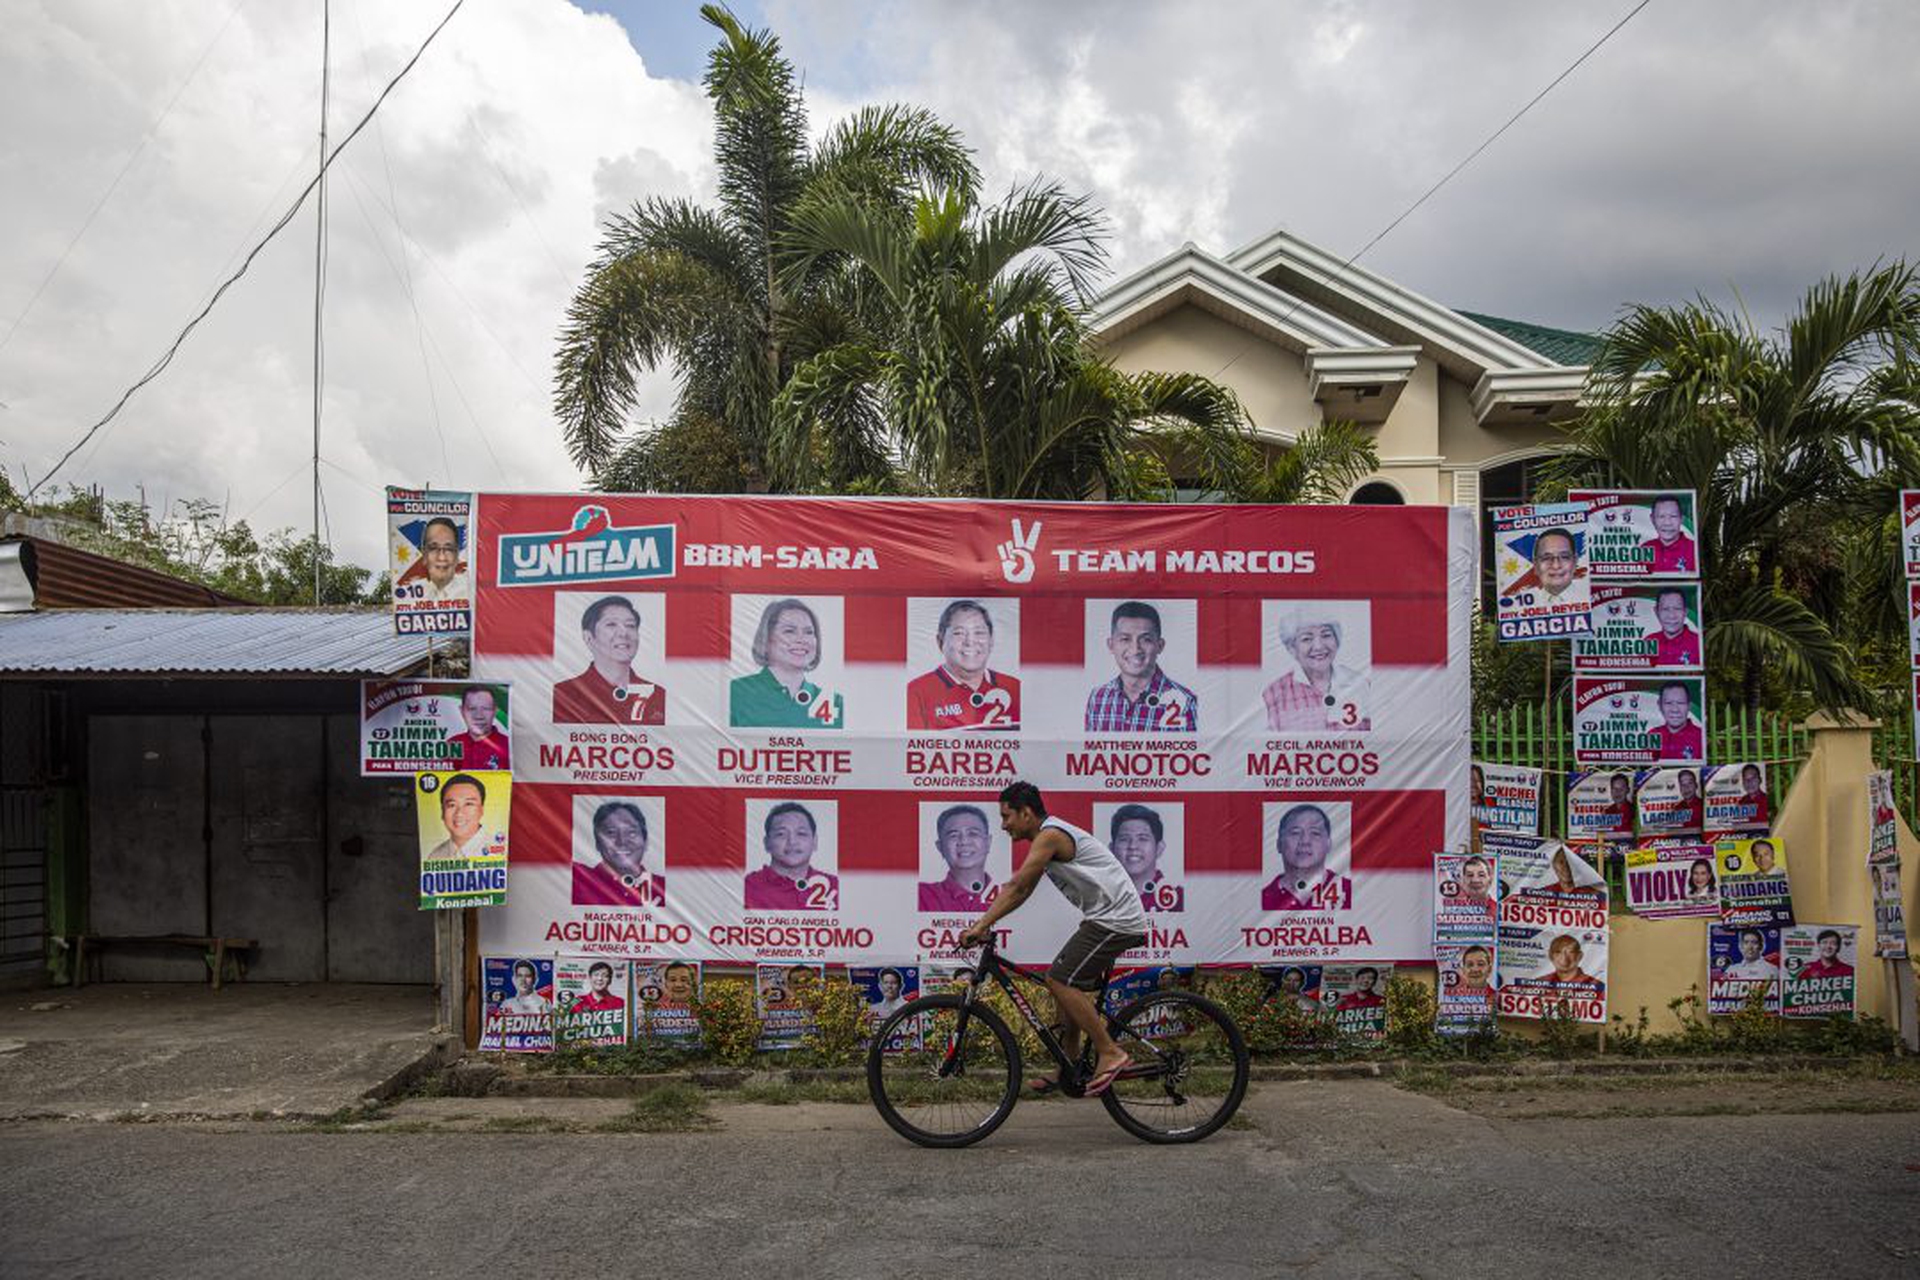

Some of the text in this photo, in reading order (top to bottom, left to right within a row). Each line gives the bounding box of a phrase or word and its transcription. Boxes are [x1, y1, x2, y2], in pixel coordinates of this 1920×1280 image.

[404, 503, 469, 514] COUNCILOR
[1498, 506, 1535, 518] VOTE!
[1513, 513, 1585, 529] COUNCILOR
[1593, 534, 1641, 546] JIMMY
[512, 536, 661, 578] UNITEAM
[684, 544, 879, 570] BBM-SARA
[1051, 549, 1316, 574] TEAM MARCOS
[1596, 565, 1649, 573] KONSEHAL
[408, 585, 424, 598] 10
[413, 599, 470, 611] JOEL REYES
[1515, 593, 1535, 606] 10
[1520, 602, 1590, 617] JOEL REYES
[397, 612, 468, 633] GARCIA
[1501, 615, 1588, 638] GARCIA
[1597, 627, 1645, 639] JIMMY
[1577, 640, 1658, 655] TANAGON
[1600, 658, 1650, 667] KONSEHAL
[1165, 702, 1182, 725] 2
[1342, 702, 1358, 725] 3
[1600, 720, 1648, 731] JIMMY
[391, 727, 448, 740] JIMMY
[570, 732, 648, 744] BONG BONG
[768, 737, 804, 747] SARA
[907, 739, 1020, 750] ANGELO MARCOS
[1084, 741, 1197, 751] MATTHEW MARCOS
[1266, 740, 1364, 750] CECIL ARANETA
[1579, 733, 1661, 749] TANAGON
[367, 741, 464, 758] TANAGON
[1601, 752, 1653, 760] KONSEHAL
[540, 744, 675, 770] MARCOS
[718, 748, 852, 773] DUTERTE
[906, 752, 1017, 775] BARBA
[1247, 752, 1379, 775] MARCOS
[394, 760, 455, 770] KONSEHAL
[1066, 753, 1211, 776] MANOTOC
[573, 770, 645, 781] PRESIDENT
[734, 774, 838, 785] VICE PRESIDENT
[913, 776, 1012, 787] CONGRESSMAN
[1264, 777, 1366, 787] VICE GOVERNOR
[421, 777, 436, 789] 16
[1105, 778, 1177, 788] GOVERNOR
[1642, 809, 1692, 825] LAGMAY
[1707, 803, 1757, 817] LAGMAY
[1728, 856, 1740, 869] 16
[423, 869, 505, 896] QUIDANG
[1442, 882, 1458, 895] 13
[1628, 869, 1688, 903] VIOLY
[1720, 881, 1789, 897] QUIDANG
[810, 882, 826, 905] 2
[1158, 884, 1174, 908] 6
[1312, 883, 1339, 905] 14
[436, 895, 494, 909] Konsehal
[584, 912, 652, 921] MACARTHUR
[743, 917, 839, 926] GIAN CARLO ANGELO
[1280, 917, 1334, 926] JONATHAN
[1503, 904, 1606, 928] ISOSTOMO
[545, 922, 692, 944] AGUINALDO
[709, 926, 873, 948] CRISOSTOMO
[918, 929, 1012, 948] GAT
[1144, 929, 1189, 948] INA
[1241, 926, 1372, 947] TORRALBA
[755, 948, 803, 957] MEMBER,
[1272, 948, 1319, 957] MEMBER,
[1788, 957, 1797, 970] 5
[1441, 972, 1457, 986] 13
[1784, 975, 1852, 995] MARKEE
[562, 991, 570, 1003] 5
[1110, 989, 1119, 1000] 6
[1327, 993, 1337, 1005] 5
[1791, 991, 1844, 1006] CHUA
[1334, 1007, 1384, 1023] ARKEE
[1798, 1002, 1852, 1015] KONSEHAL
[487, 1014, 552, 1034] MEDINA
[556, 1009, 623, 1028] MARKEE
[564, 1024, 615, 1040] CHUA
